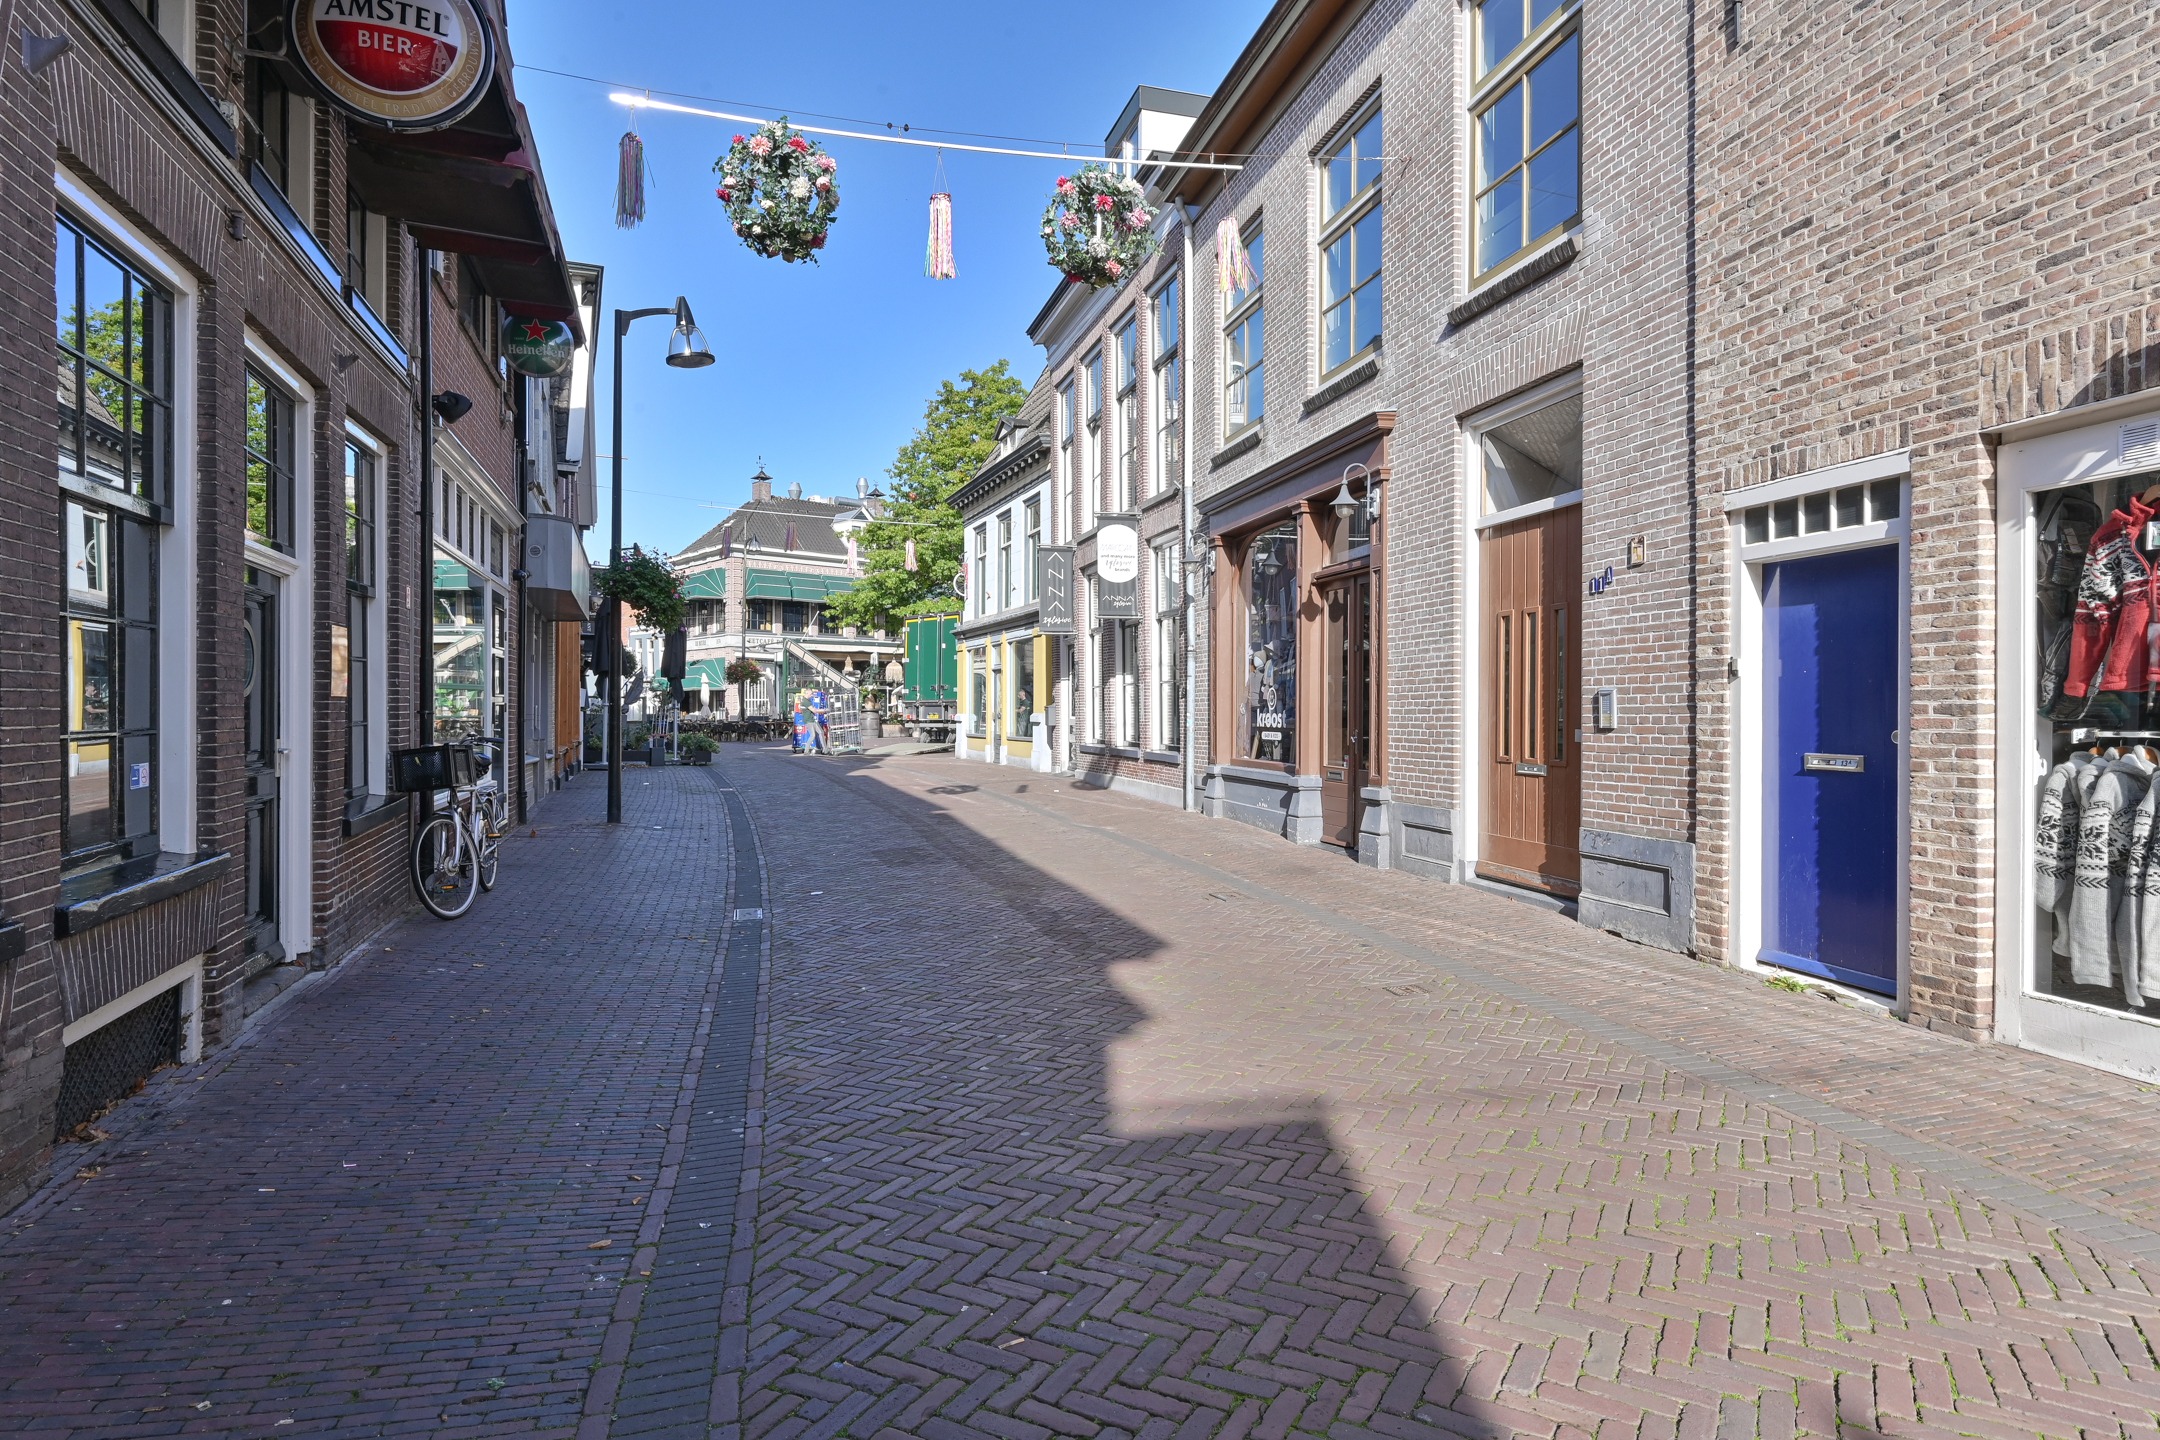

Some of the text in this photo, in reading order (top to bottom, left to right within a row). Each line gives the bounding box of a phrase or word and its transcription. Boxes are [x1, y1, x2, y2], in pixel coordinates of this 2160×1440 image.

[324, 0, 449, 37] AMSTEL
[357, 29, 412, 56] BIER
[310, 56, 326, 74] DE
[326, 75, 377, 110] AMSTEL
[384, 93, 446, 114] TRADITIE
[447, 29, 480, 98] GEBROUWEN
[508, 343, 565, 358] Heineken
[1256, 708, 1287, 728] kroost
